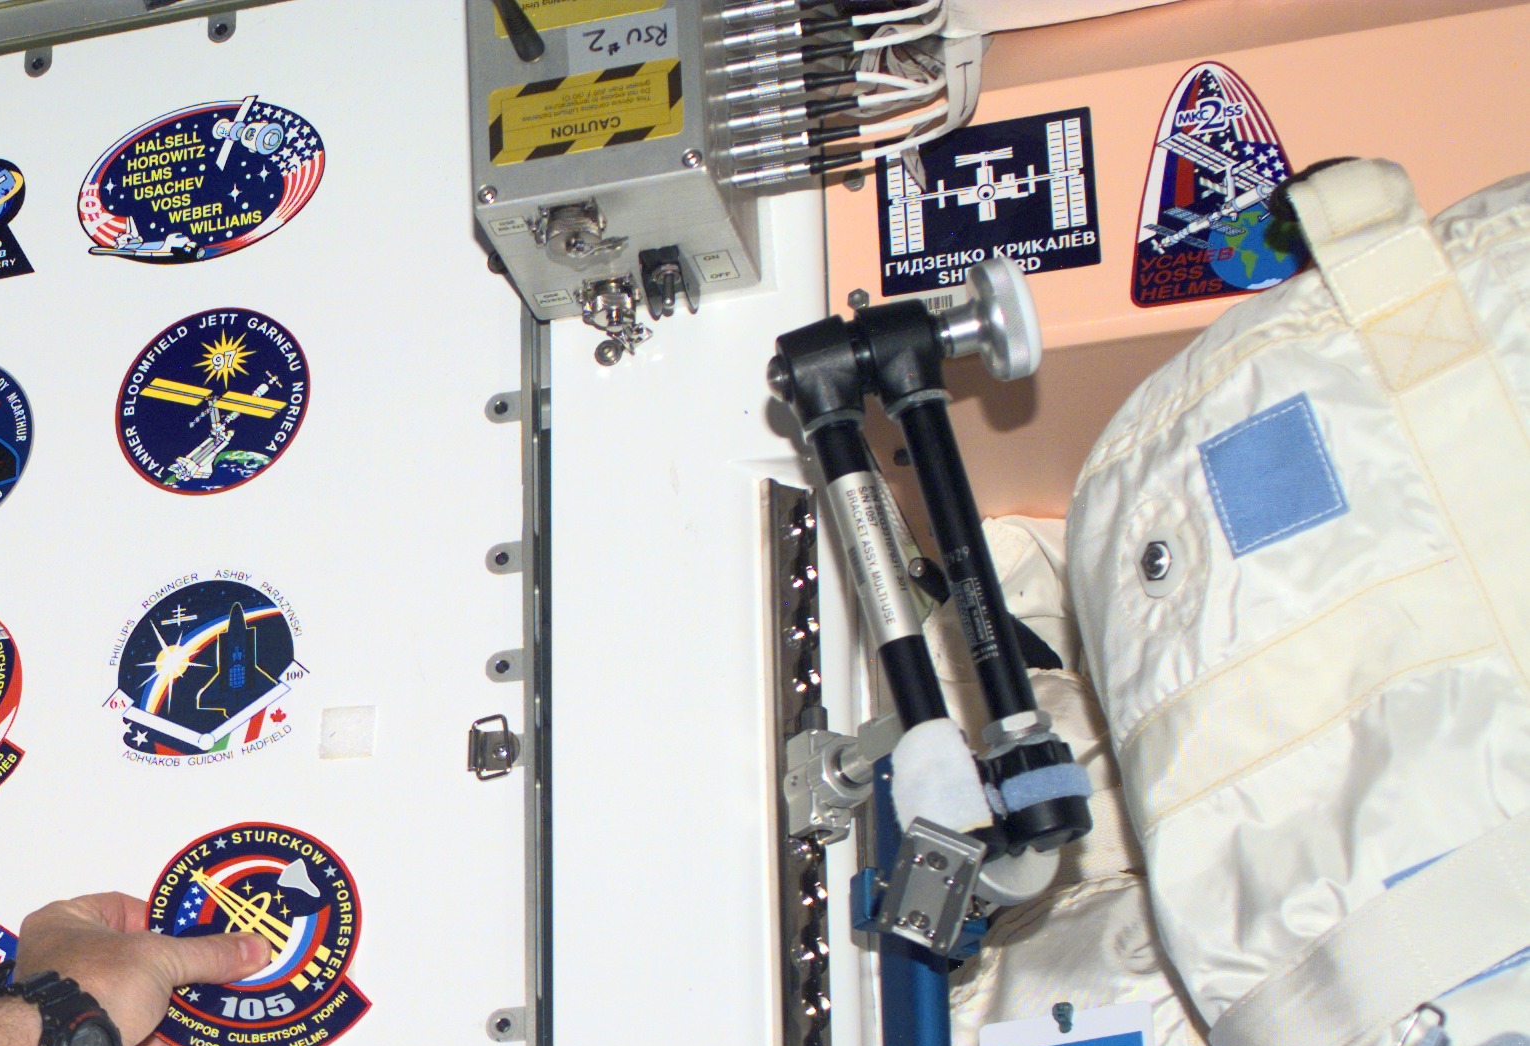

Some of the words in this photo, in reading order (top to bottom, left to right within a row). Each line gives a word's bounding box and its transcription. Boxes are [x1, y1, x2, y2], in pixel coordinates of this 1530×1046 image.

[551, 116, 620, 140] CAUTION
[135, 131, 202, 154] HALSELL
[127, 145, 206, 172] HOROWITZ
[122, 167, 172, 188] HELMS
[134, 175, 204, 202] USACHEV
[151, 194, 192, 212] VOSS
[168, 203, 222, 224] WEBER
[190, 211, 262, 236] WILLIAMS
[885, 248, 986, 278] ГИДЗЕНКО
[1140, 246, 1236, 272] УСАЧЕВ
[1139, 265, 1204, 288] VOSS
[1140, 277, 1224, 302] HELMS
[198, 312, 238, 330] JETT
[246, 317, 302, 374] GARNEAU
[123, 325, 188, 418] BLOOMFIELD
[211, 349, 238, 372] 97
[265, 381, 304, 454] NORIEGA
[125, 427, 166, 480] TANNER
[846, 489, 870, 538] BRACKET
[109, 618, 136, 666] PHILLIPS
[141, 572, 200, 612] ROMINGER
[214, 568, 254, 584] ASHBY
[259, 581, 304, 640] PARAZYNSKI
[284, 669, 304, 682] 100
[187, 750, 234, 766] GUIDONI
[241, 723, 292, 756] HADFIELD
[152, 844, 212, 920] HOROWITZ
[231, 830, 328, 866] STURCKOW
[321, 879, 352, 980] FORRESTER
[220, 992, 296, 1020] 105
[227, 1022, 308, 1044] CULBERTSON
[311, 991, 350, 1024] ТЮРИН
